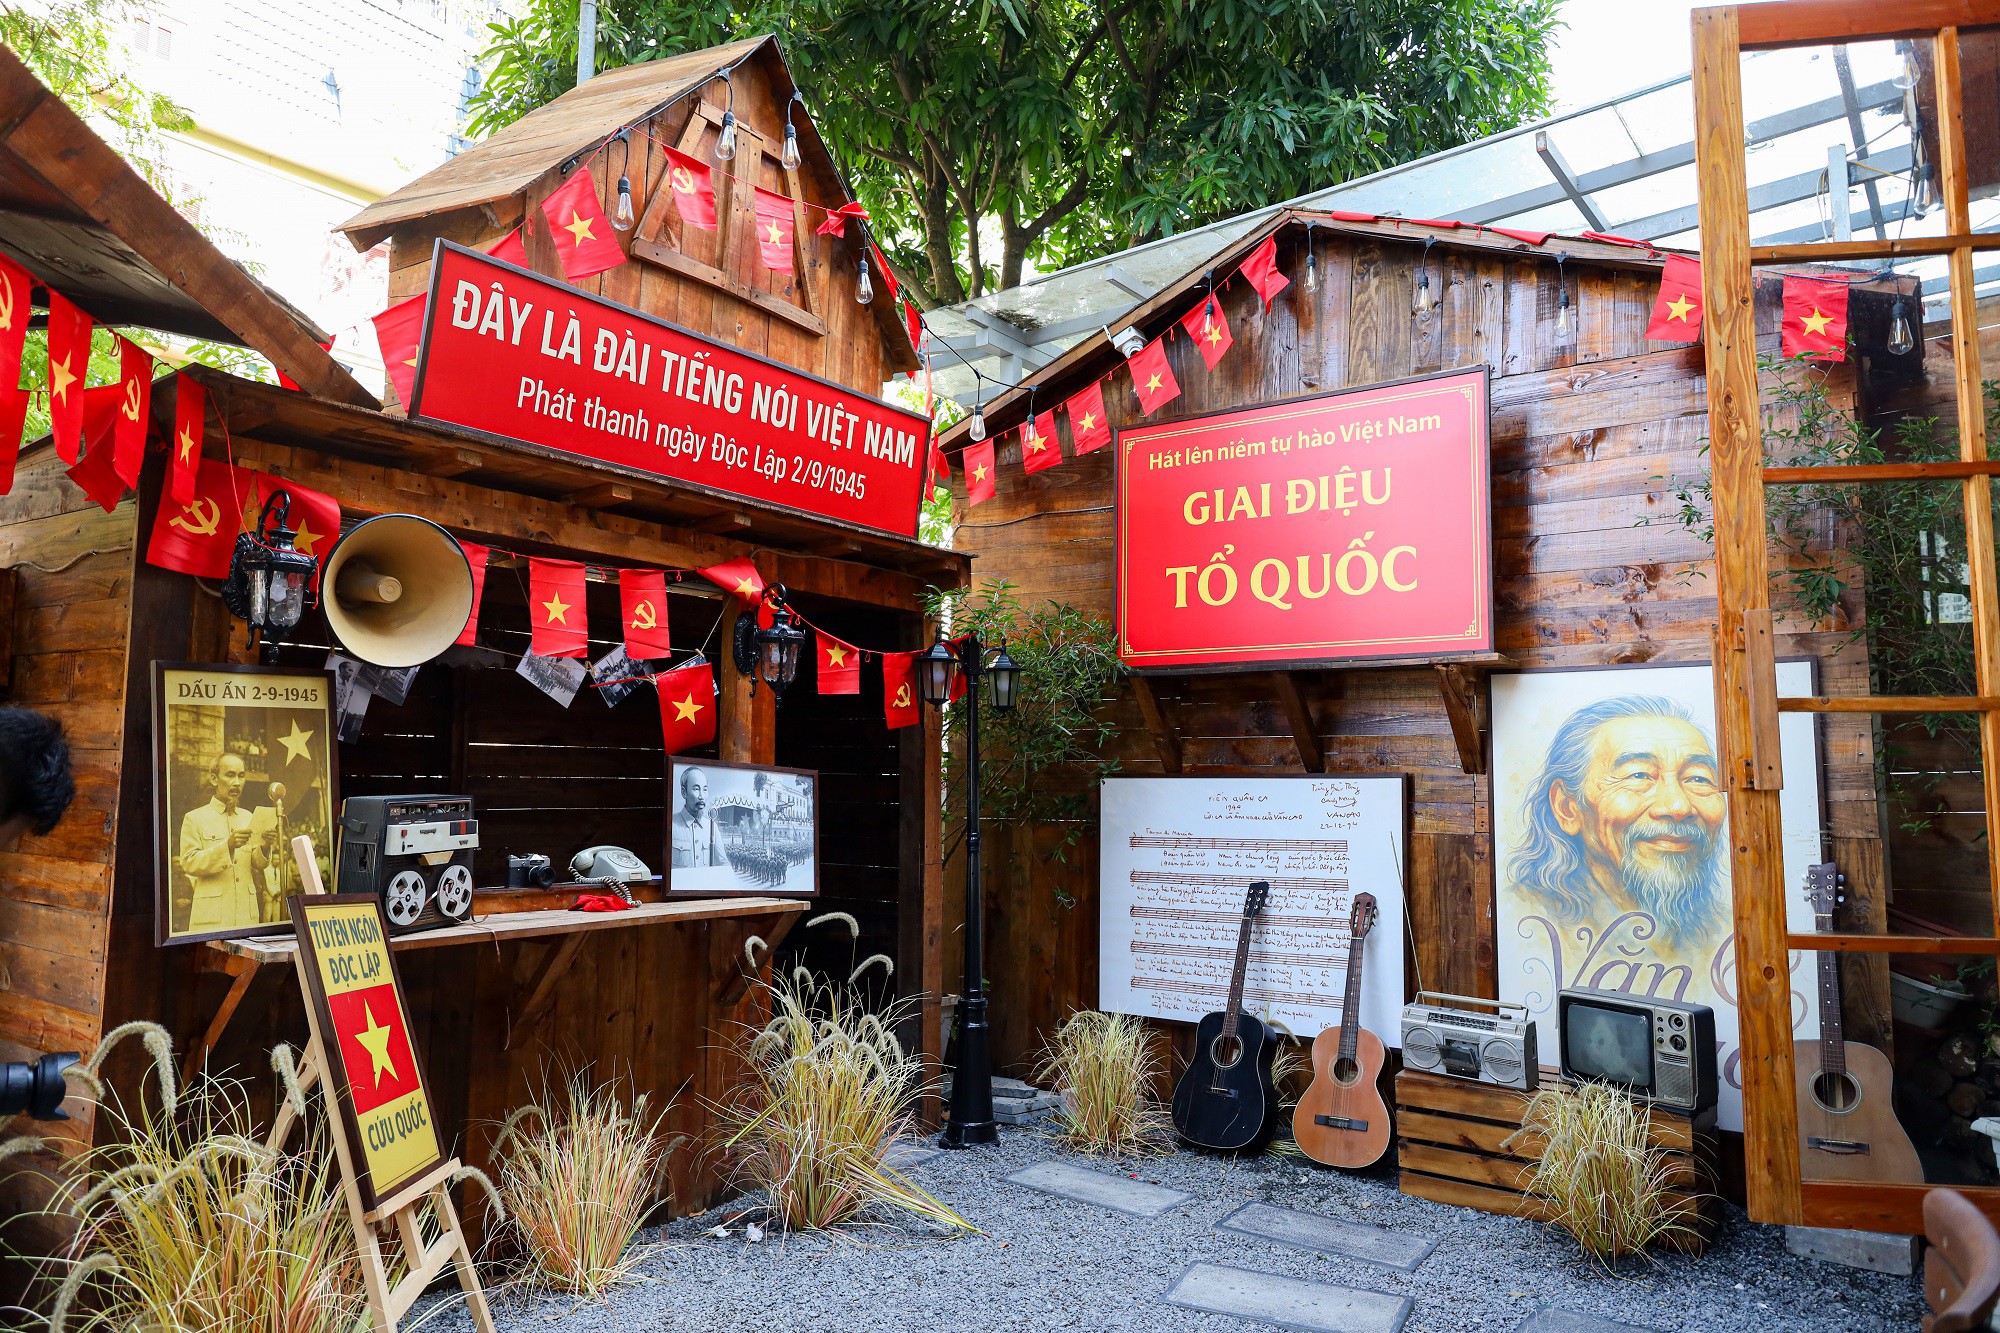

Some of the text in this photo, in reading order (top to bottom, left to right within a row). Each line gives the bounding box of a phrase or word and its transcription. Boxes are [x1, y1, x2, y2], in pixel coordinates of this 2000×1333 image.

[452, 280, 917, 468] ĐÂY LÀ ĐÀI TIẾNG NÓI VIỆT NAM
[517, 376, 866, 500] Phát thanh ngày Độc Lập 2/9/1945
[1149, 414, 1441, 470] Hát lên niềm tự hào Việt Nam
[1183, 465, 1392, 526] GIAI ĐIỆU
[1165, 530, 1418, 610] TỔ QUỐC
[178, 679, 319, 702] DẤU ẤN 2-9-1945
[310, 917, 381, 949] TUYÊN NGÔN
[328, 951, 381, 988] ĐỘC LẬP
[367, 1096, 427, 1152] CỨU QUỐC
